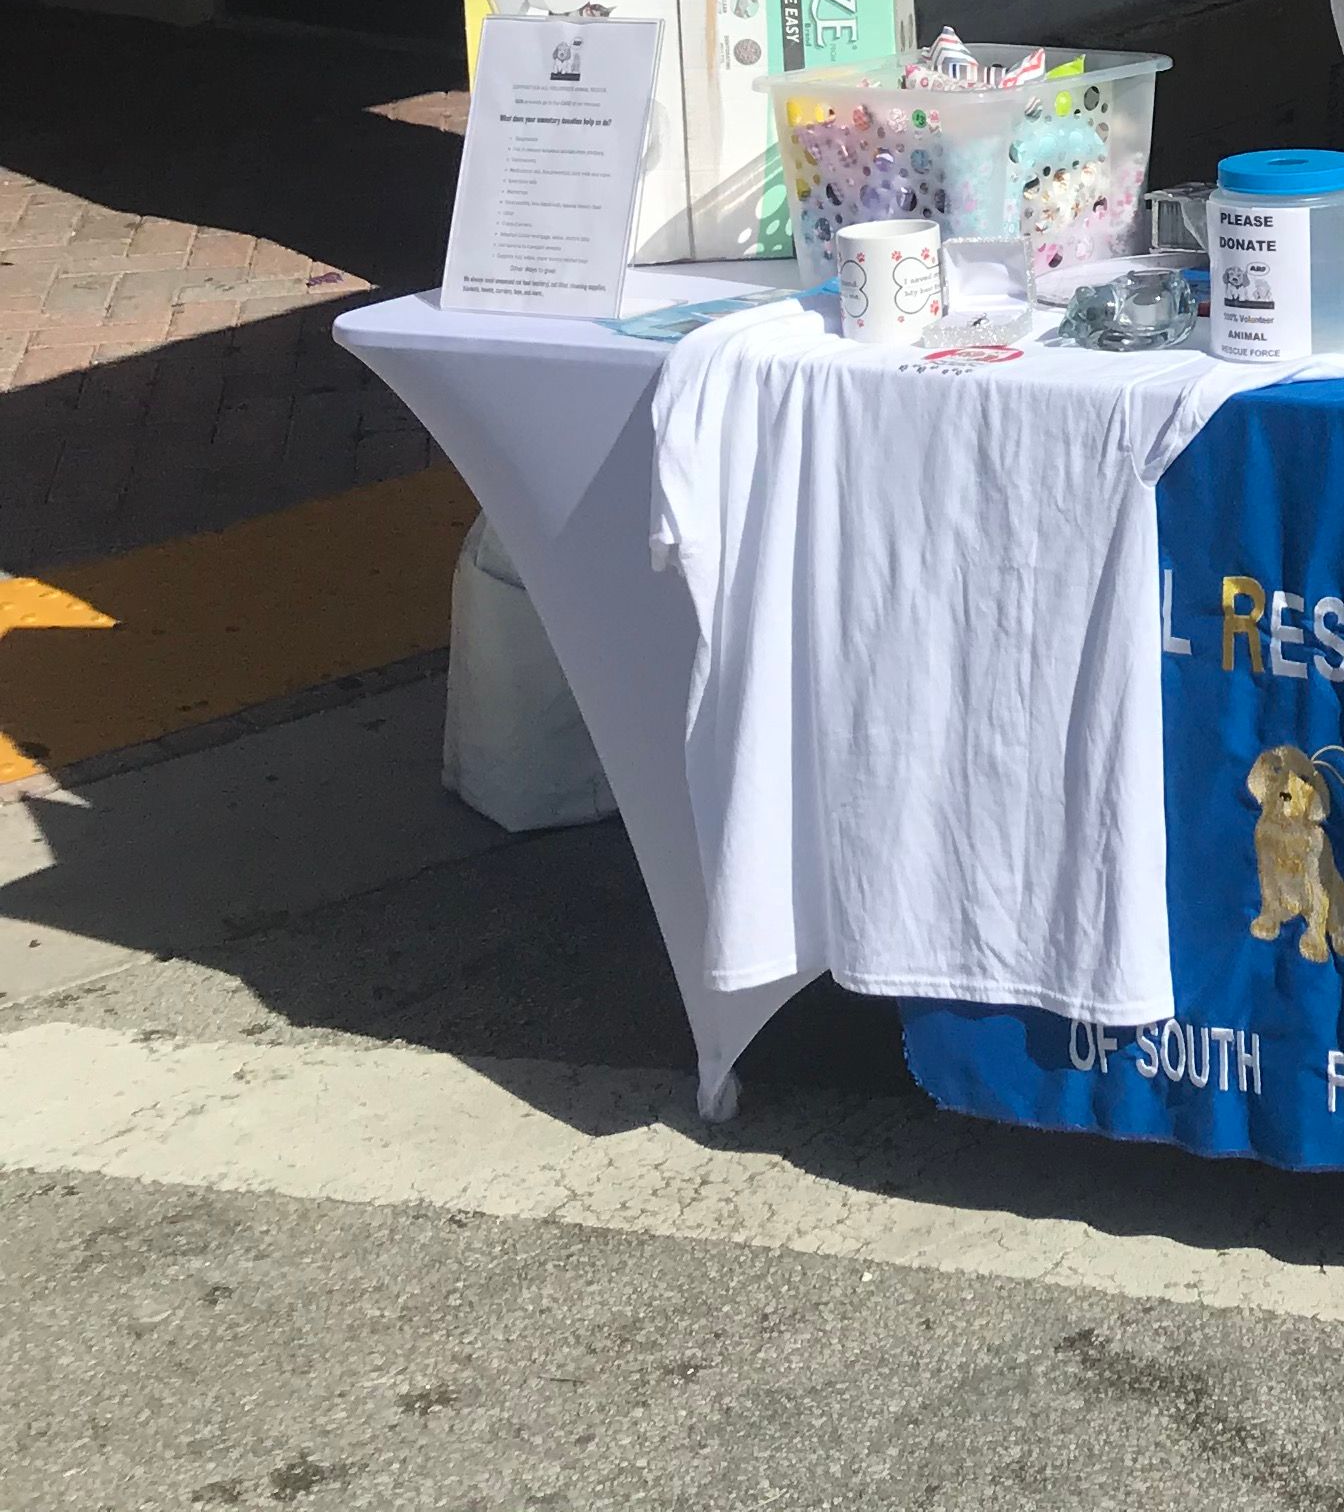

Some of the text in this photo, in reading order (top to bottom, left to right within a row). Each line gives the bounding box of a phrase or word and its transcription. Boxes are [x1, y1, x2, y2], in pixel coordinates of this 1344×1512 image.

[784, 8, 801, 43] EASY
[1220, 212, 1274, 228] PLEASE
[1219, 236, 1277, 252] DONATE
[1239, 315, 1274, 325] Volunteer
[1228, 330, 1267, 341] ANIMAL
[1221, 344, 1280, 358] RESCUE FORCE
[1068, 1020, 1119, 1076] OF
[1135, 1022, 1263, 1095] SOUTH
